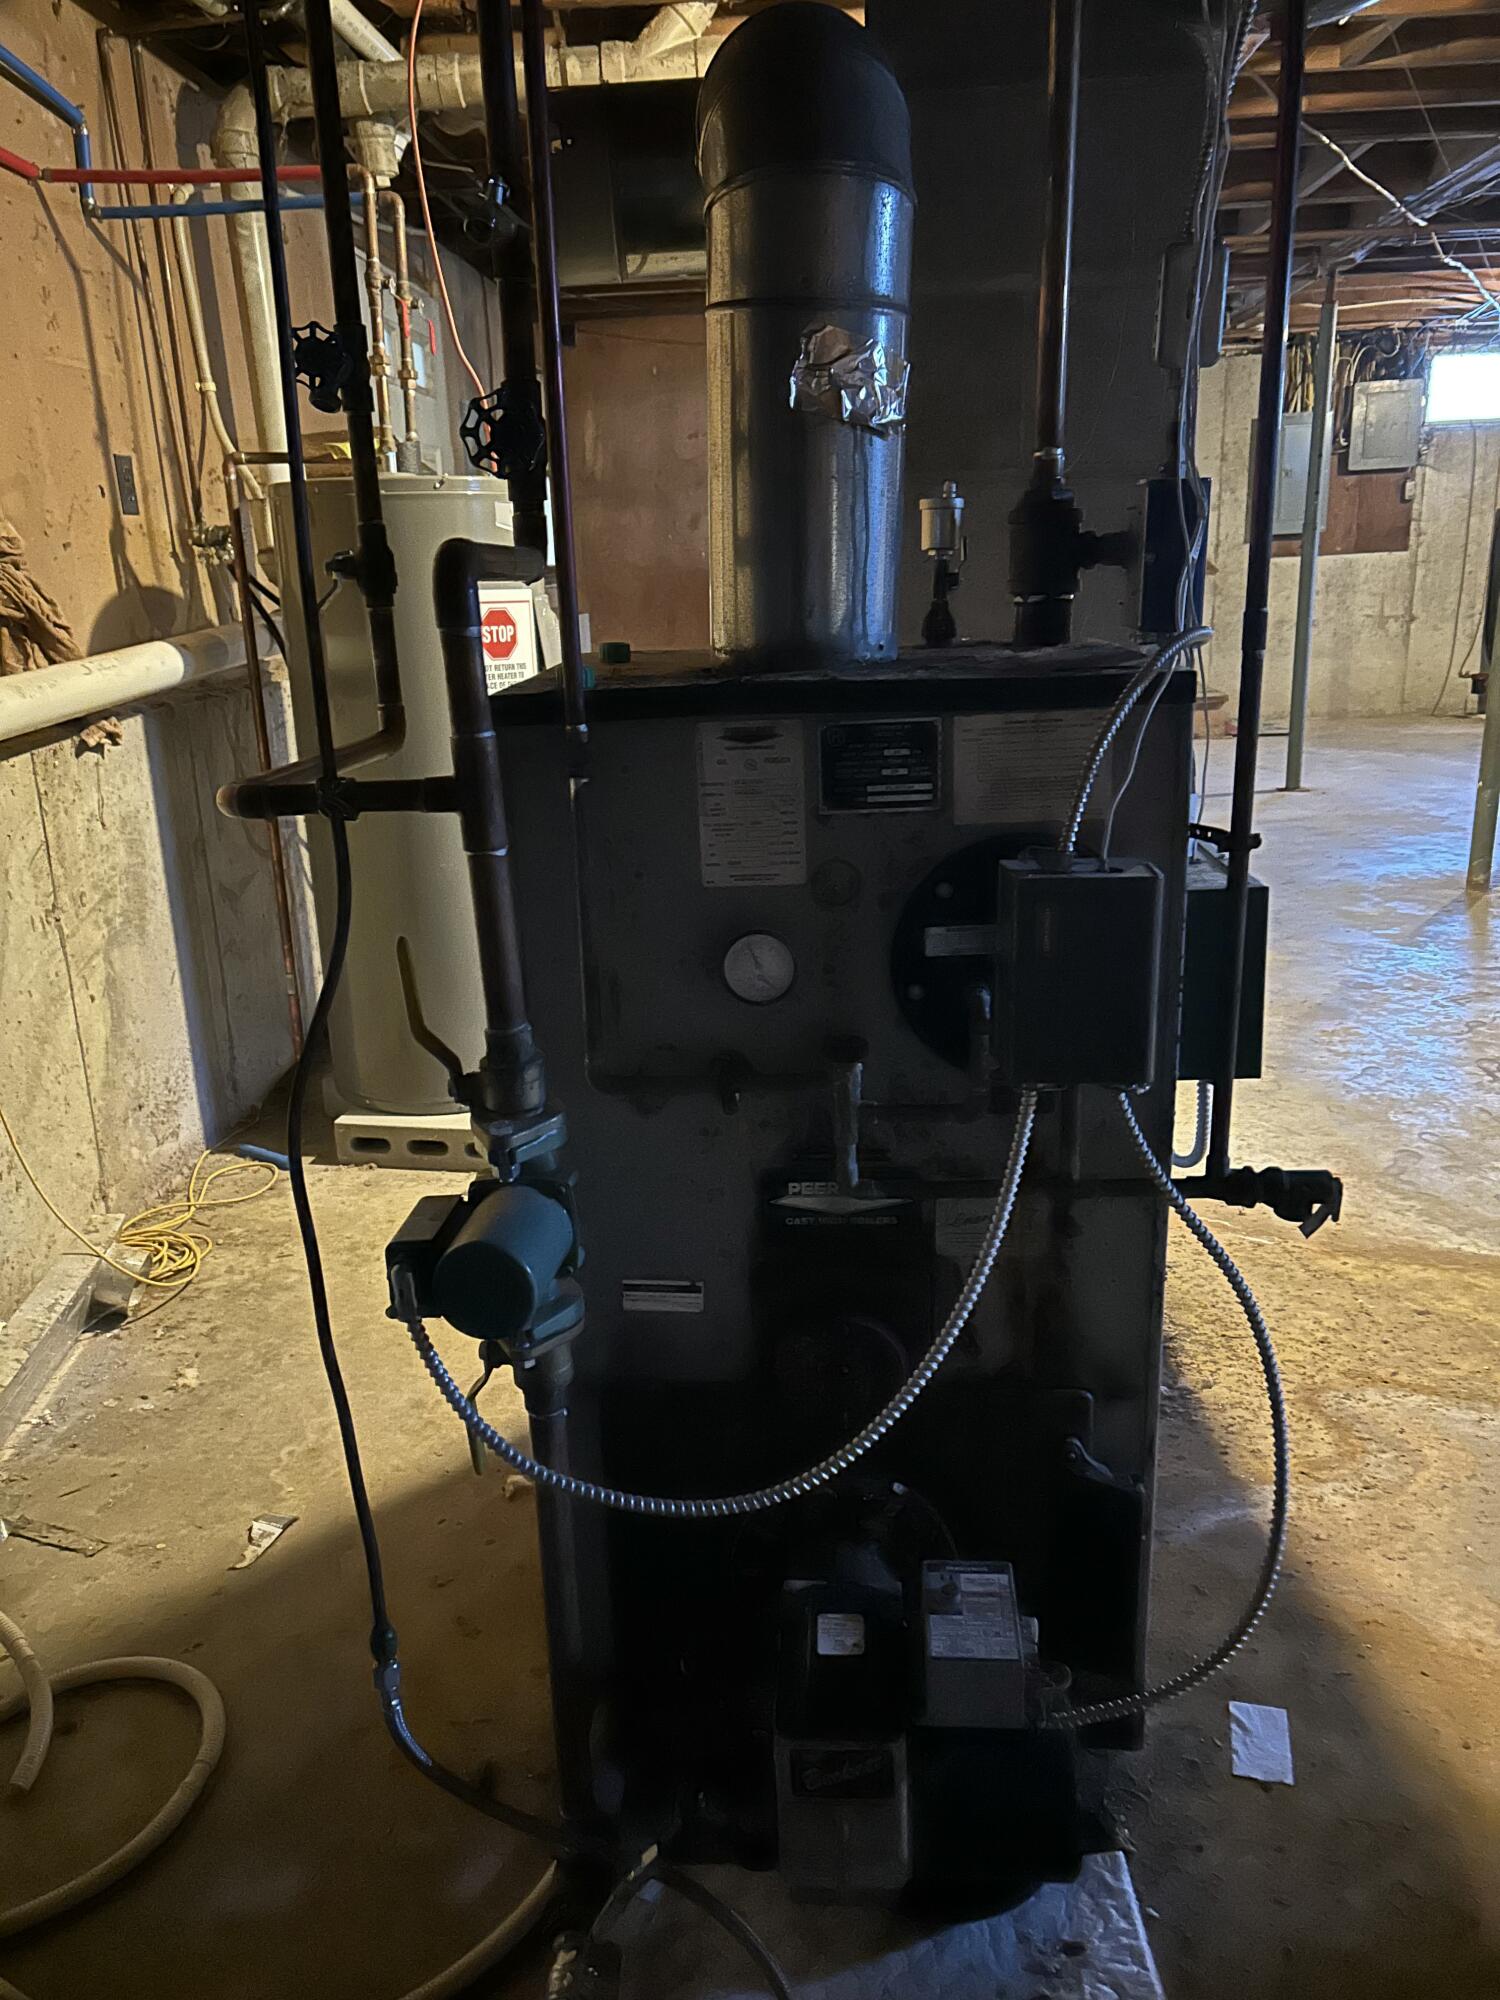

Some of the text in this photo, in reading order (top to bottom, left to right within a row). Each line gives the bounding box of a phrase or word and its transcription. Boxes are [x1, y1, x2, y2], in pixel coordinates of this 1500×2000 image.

[481, 625, 514, 643] STOP
[516, 662, 527, 670] THIS
[497, 672, 517, 680] HEATER
[788, 1182, 839, 1195] PEER
